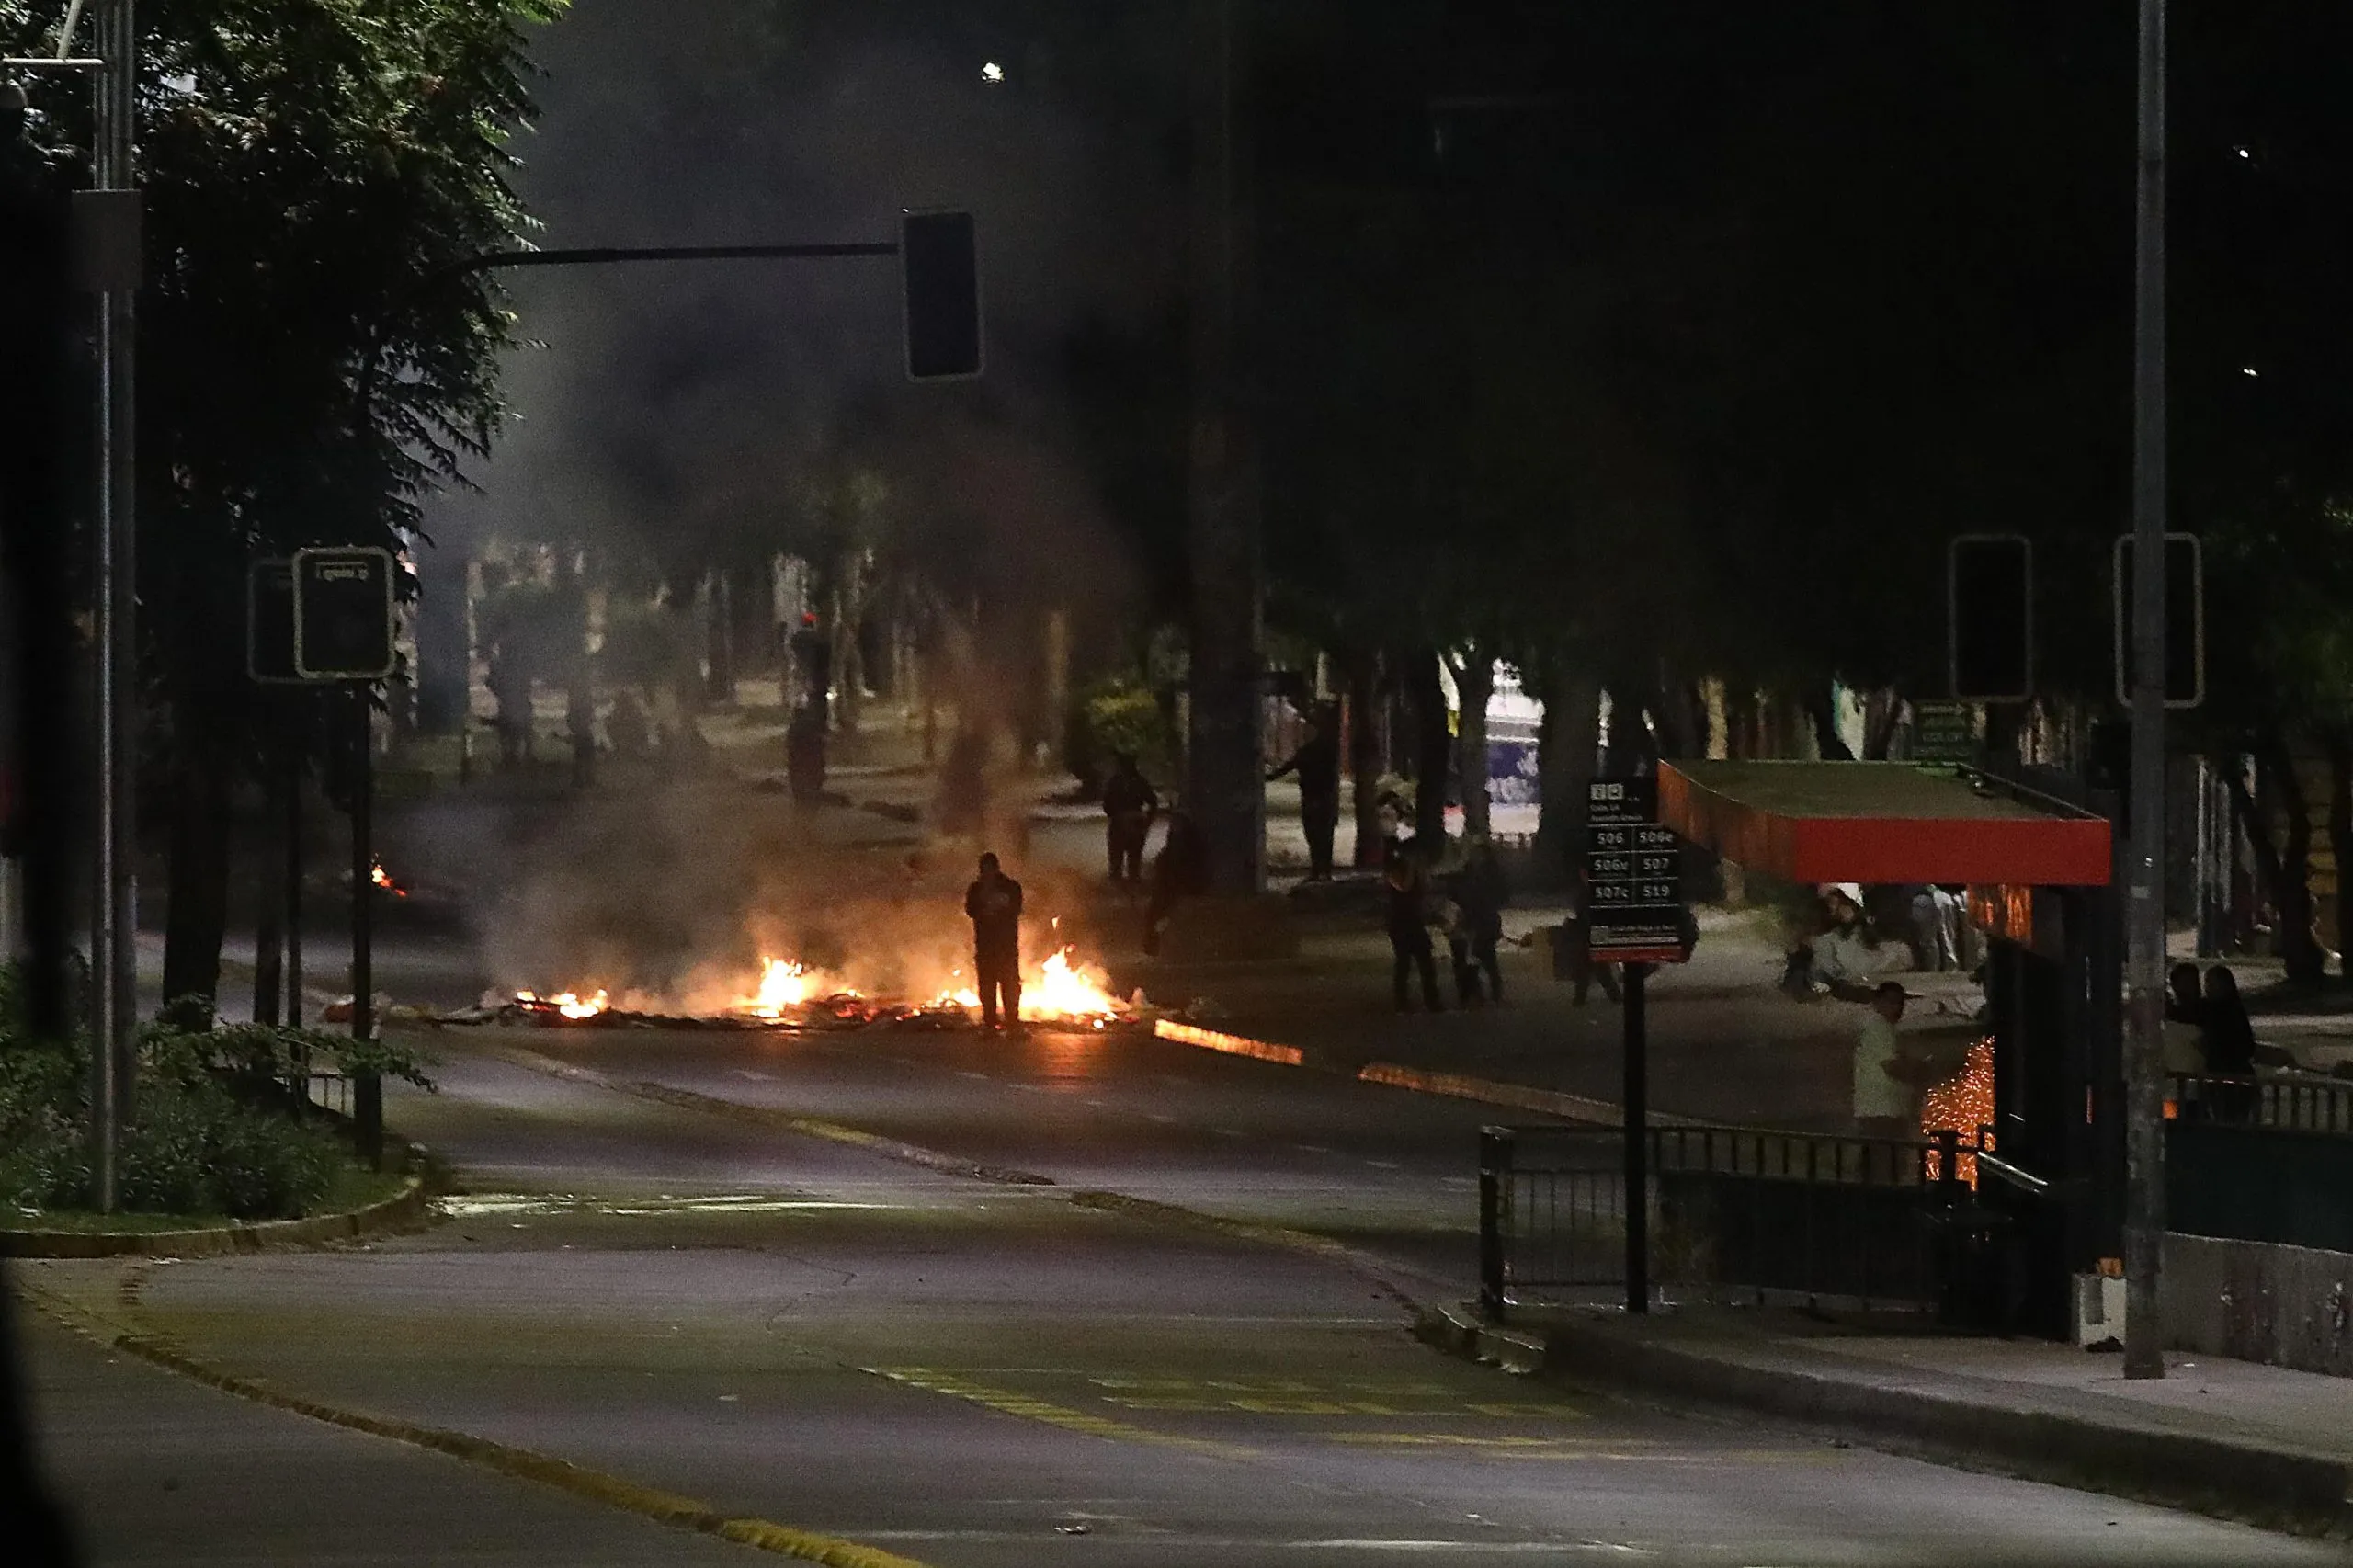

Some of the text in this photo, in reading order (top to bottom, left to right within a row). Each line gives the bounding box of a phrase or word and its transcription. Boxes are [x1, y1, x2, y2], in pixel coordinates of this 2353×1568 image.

[1597, 832, 1625, 845] 506
[1639, 830, 1674, 844] 506e
[1643, 858, 1670, 870] 507
[1595, 886, 1630, 899] 507c
[1643, 884, 1670, 898] 519
